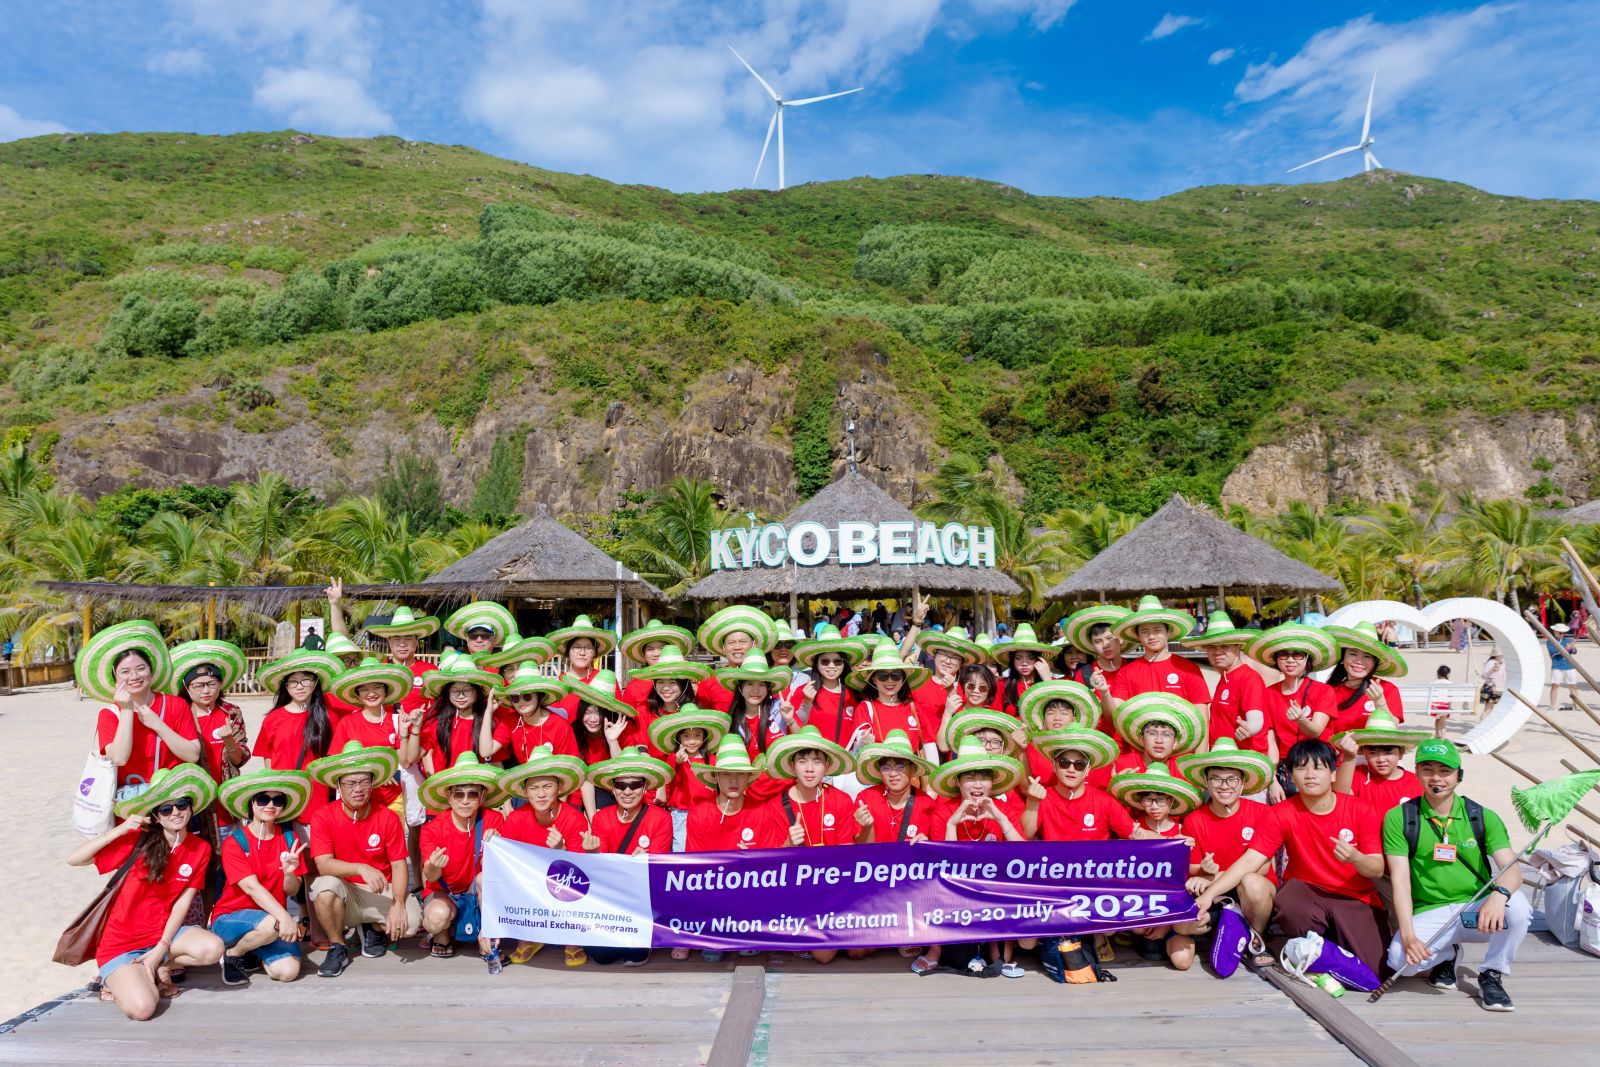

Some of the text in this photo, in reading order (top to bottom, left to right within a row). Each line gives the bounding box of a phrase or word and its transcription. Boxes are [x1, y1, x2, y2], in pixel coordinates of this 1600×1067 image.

[838, 520, 996, 568] BEACH
[546, 867, 591, 893] yfu
[665, 855, 1173, 892] National Pre-Departure Orientation
[504, 905, 633, 923] YOUTH FOR UNDERSTANDING
[923, 900, 1054, 926] 18-19-20 July
[1070, 894, 1170, 918] 2025
[498, 916, 639, 934] Intercultural Exchange Programs
[669, 911, 899, 936] Quy Nhon city, Vietnam
